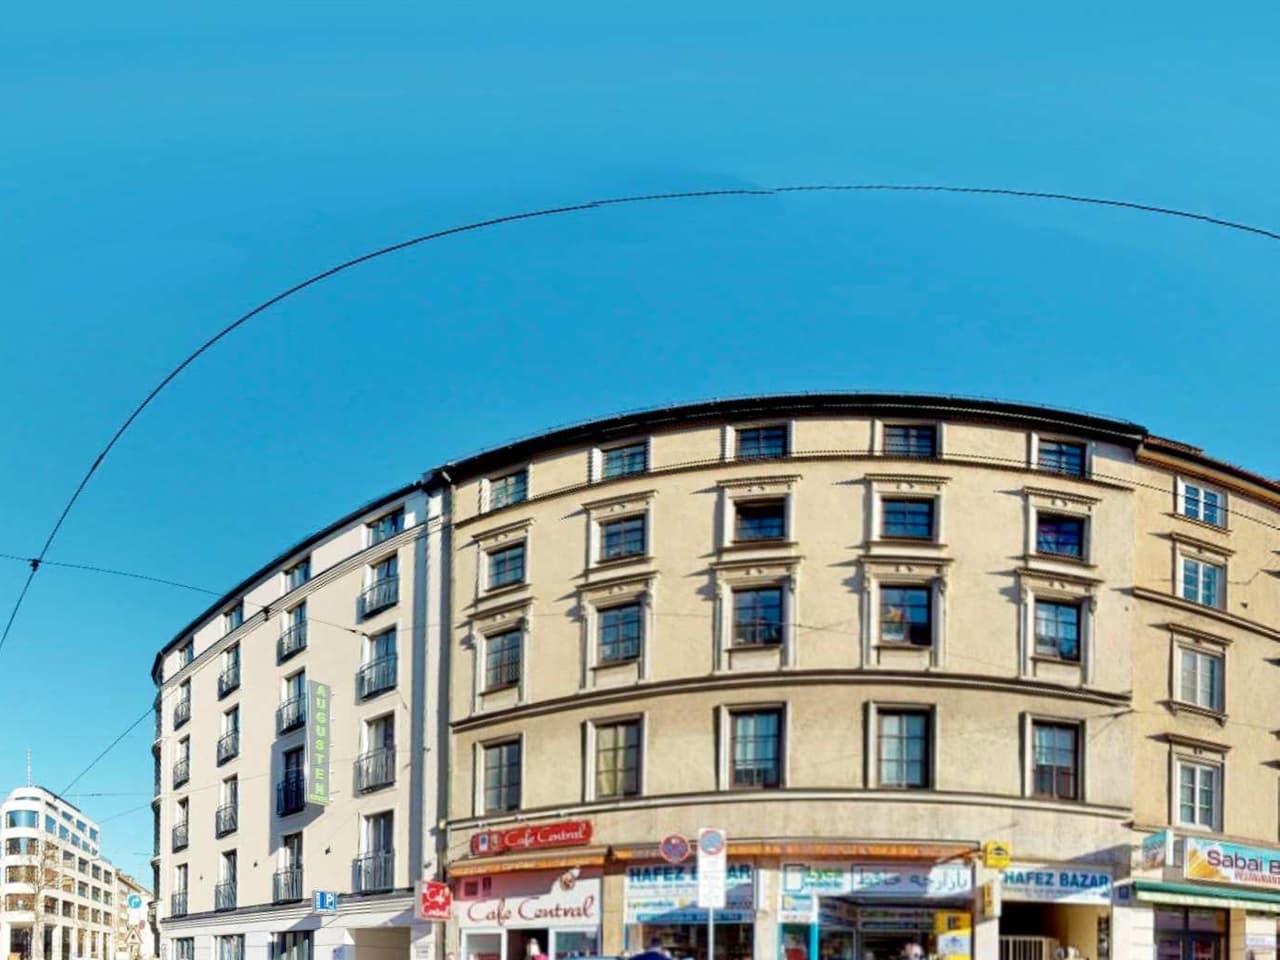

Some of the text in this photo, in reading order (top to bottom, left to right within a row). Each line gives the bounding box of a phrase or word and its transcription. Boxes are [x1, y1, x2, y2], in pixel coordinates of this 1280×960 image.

[504, 823, 587, 847] Cafe Central
[1207, 848, 1263, 872] Sabai
[630, 865, 685, 881] HAFEZ
[1004, 871, 1110, 888] HAFEZ BAZAR
[468, 894, 595, 926] Cafe Central
